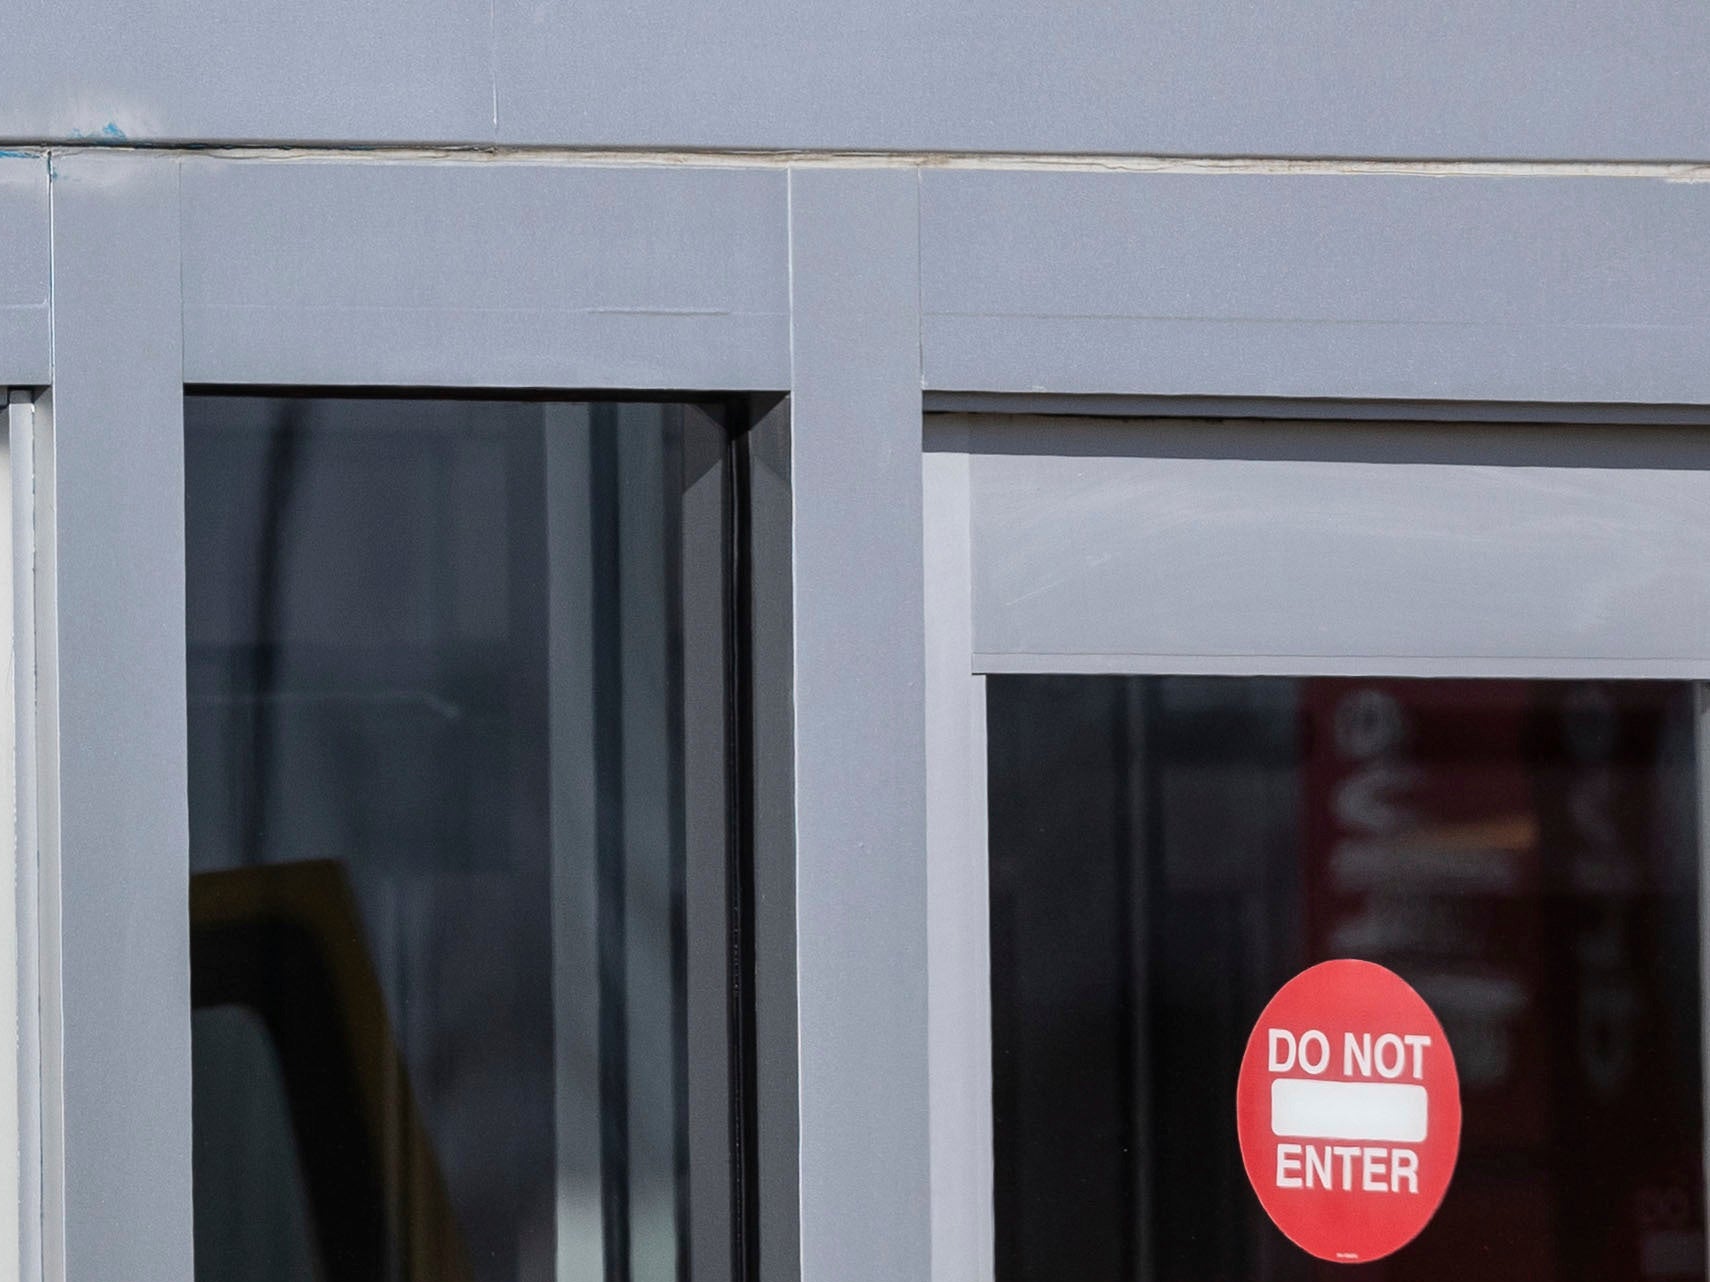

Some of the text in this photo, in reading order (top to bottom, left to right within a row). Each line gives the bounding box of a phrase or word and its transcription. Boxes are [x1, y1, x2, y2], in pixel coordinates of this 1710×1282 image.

[1269, 1027, 1431, 1080] DO NOT
[1276, 1143, 1419, 1195] ENTER
